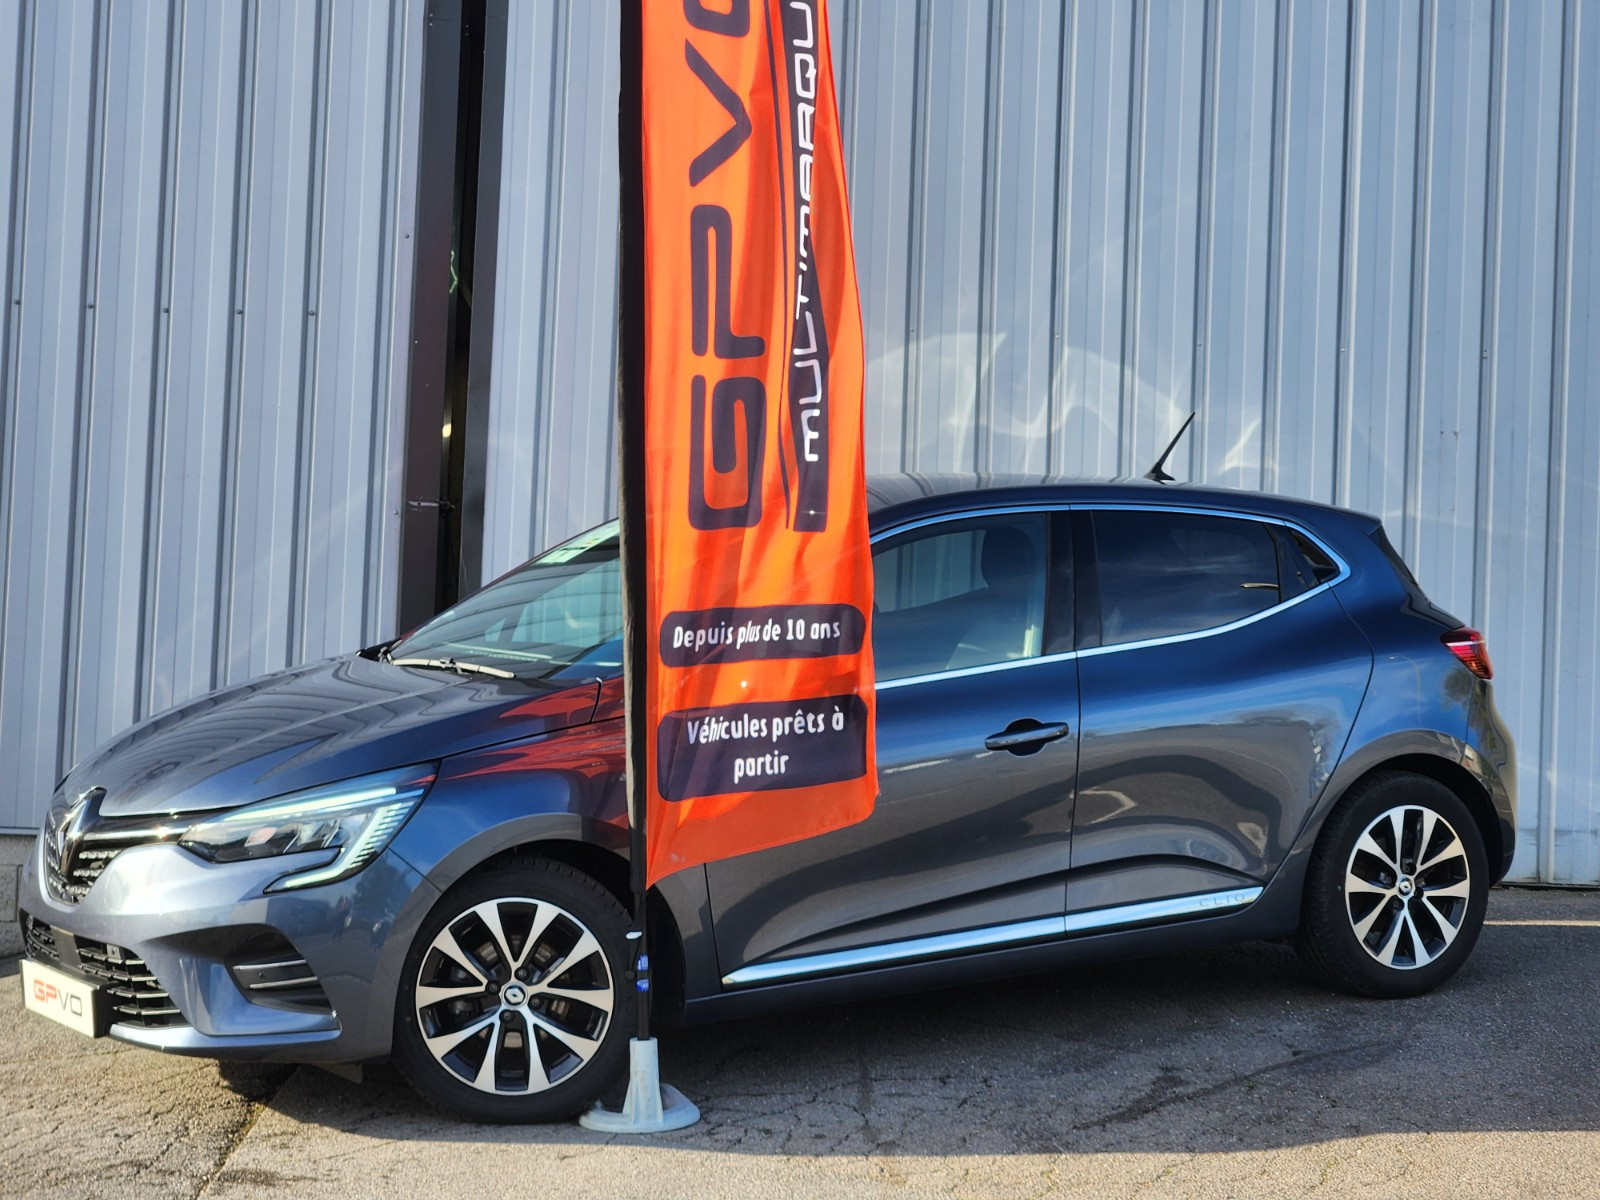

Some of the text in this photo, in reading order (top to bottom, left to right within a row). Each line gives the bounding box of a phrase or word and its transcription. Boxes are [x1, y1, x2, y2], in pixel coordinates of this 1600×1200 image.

[683, 0, 766, 530] GPV
[673, 618, 841, 652] Depuis plus de 10 ans
[687, 706, 844, 744] Véhicules prêts à
[733, 750, 790, 784] partir
[1199, 893, 1245, 907] CLIO
[33, 978, 83, 1017] GPVO
